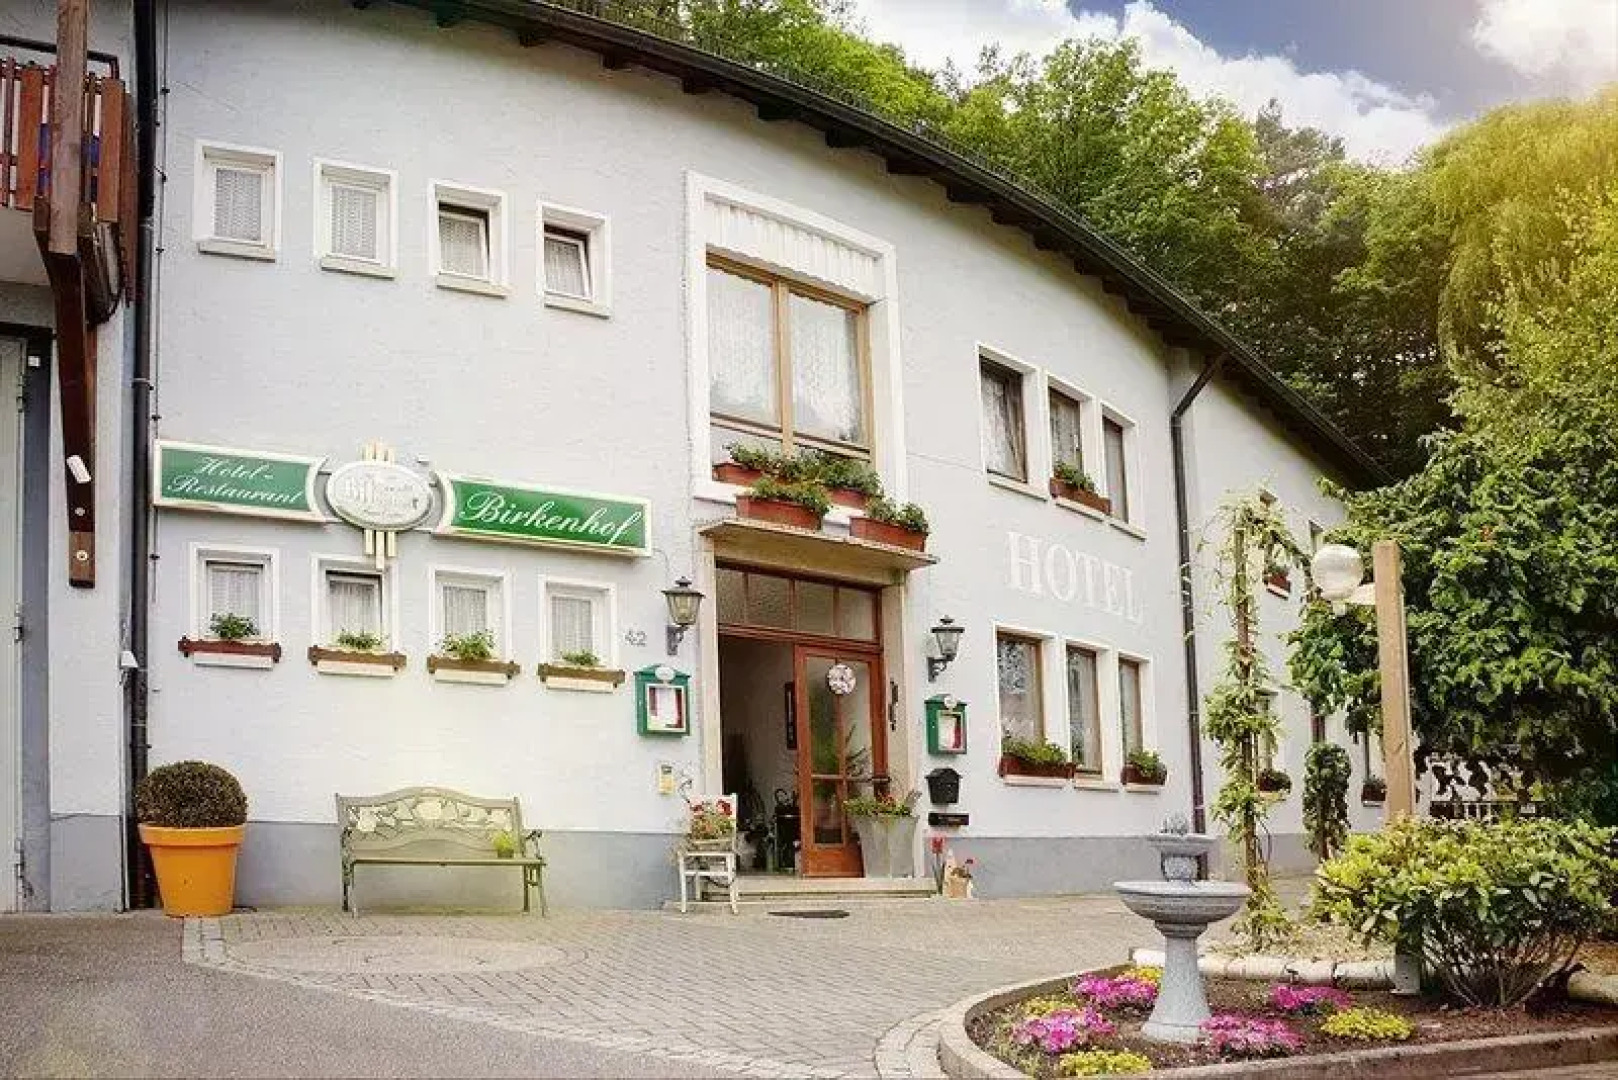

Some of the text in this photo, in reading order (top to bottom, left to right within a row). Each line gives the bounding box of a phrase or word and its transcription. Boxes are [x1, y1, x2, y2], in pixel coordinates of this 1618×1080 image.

[167, 474, 304, 506] Restaurant
[458, 490, 643, 545] Birkenhof
[1005, 531, 1145, 623] HOTEL
